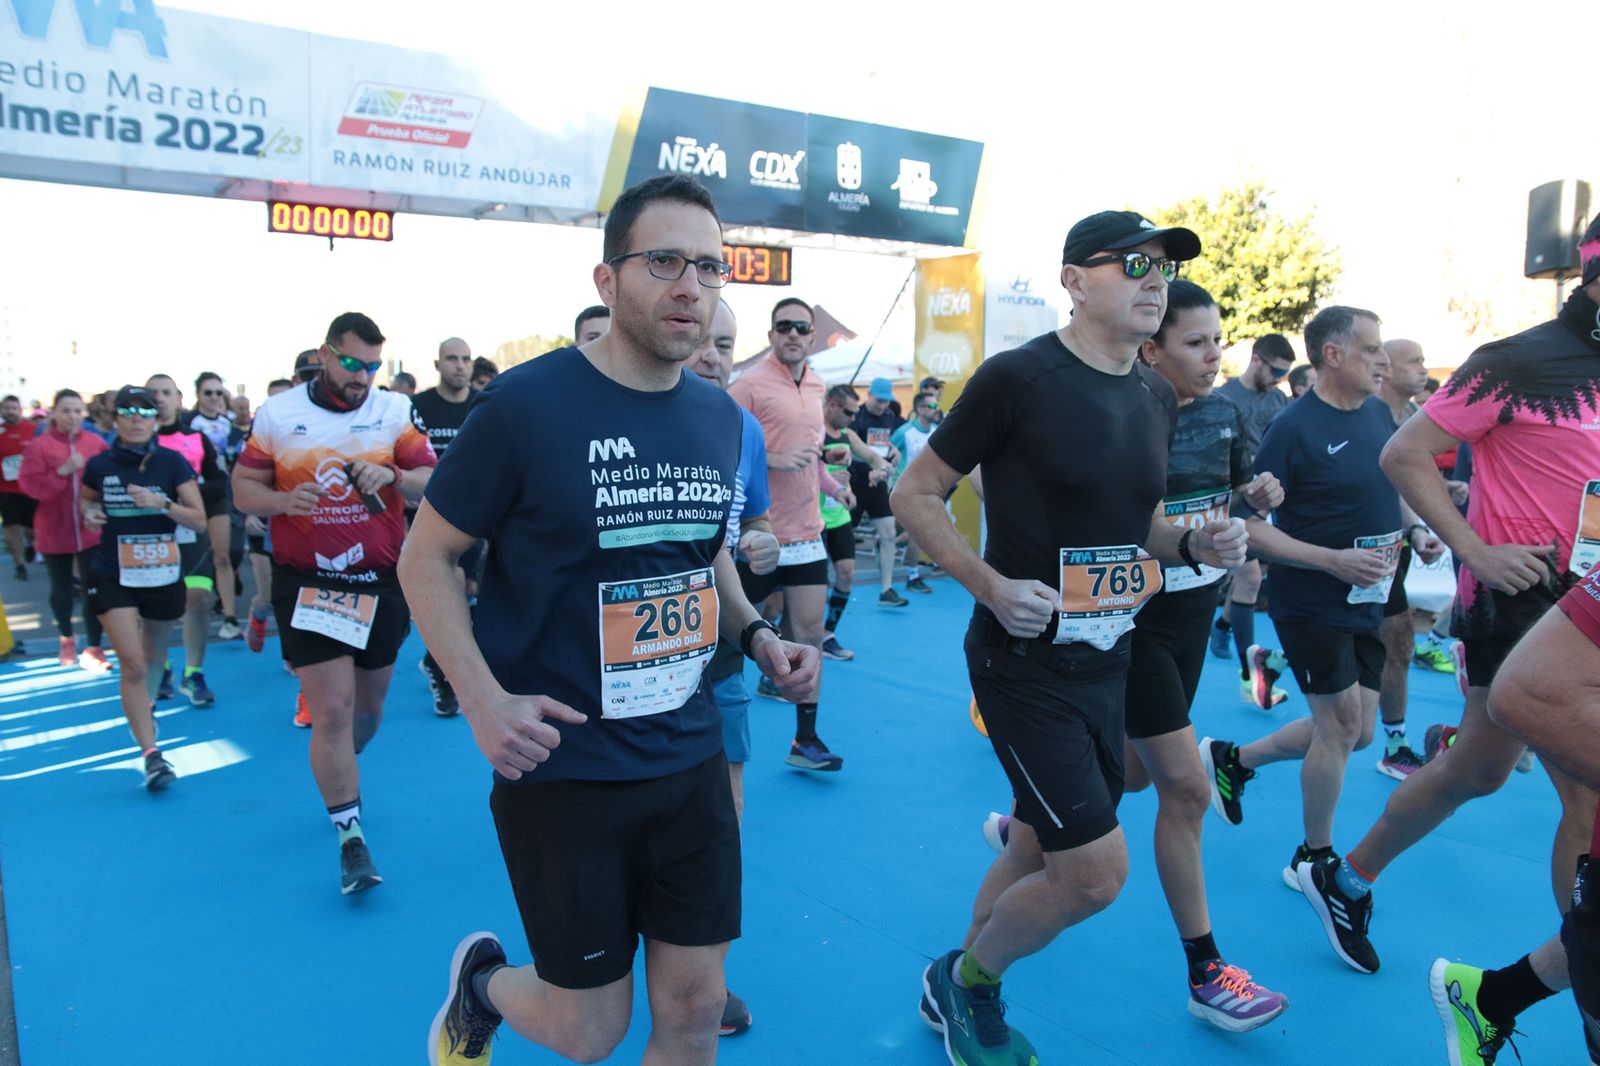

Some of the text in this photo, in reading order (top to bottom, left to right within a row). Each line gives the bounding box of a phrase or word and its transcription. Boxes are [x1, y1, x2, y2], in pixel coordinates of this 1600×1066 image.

[107, 70, 267, 117] Maratón
[367, 123, 410, 139] Prueba
[333, 149, 571, 189] RAMÓN RUIZ ANDÚJAR
[658, 141, 806, 184] NEXA CDX
[926, 289, 972, 317] NEXA
[591, 462, 721, 486] Medio Maratón
[595, 481, 674, 509] Almería
[597, 507, 724, 527] RAMÓN RUIZ ANDÚJAR
[132, 542, 169, 560] 559
[643, 586, 667, 598] Almería
[1087, 563, 1147, 598] 769
[1097, 595, 1135, 607] ANTONIO
[633, 592, 702, 643] 266
[632, 637, 682, 656] ARMANDO
[684, 632, 703, 647] DIAZ
